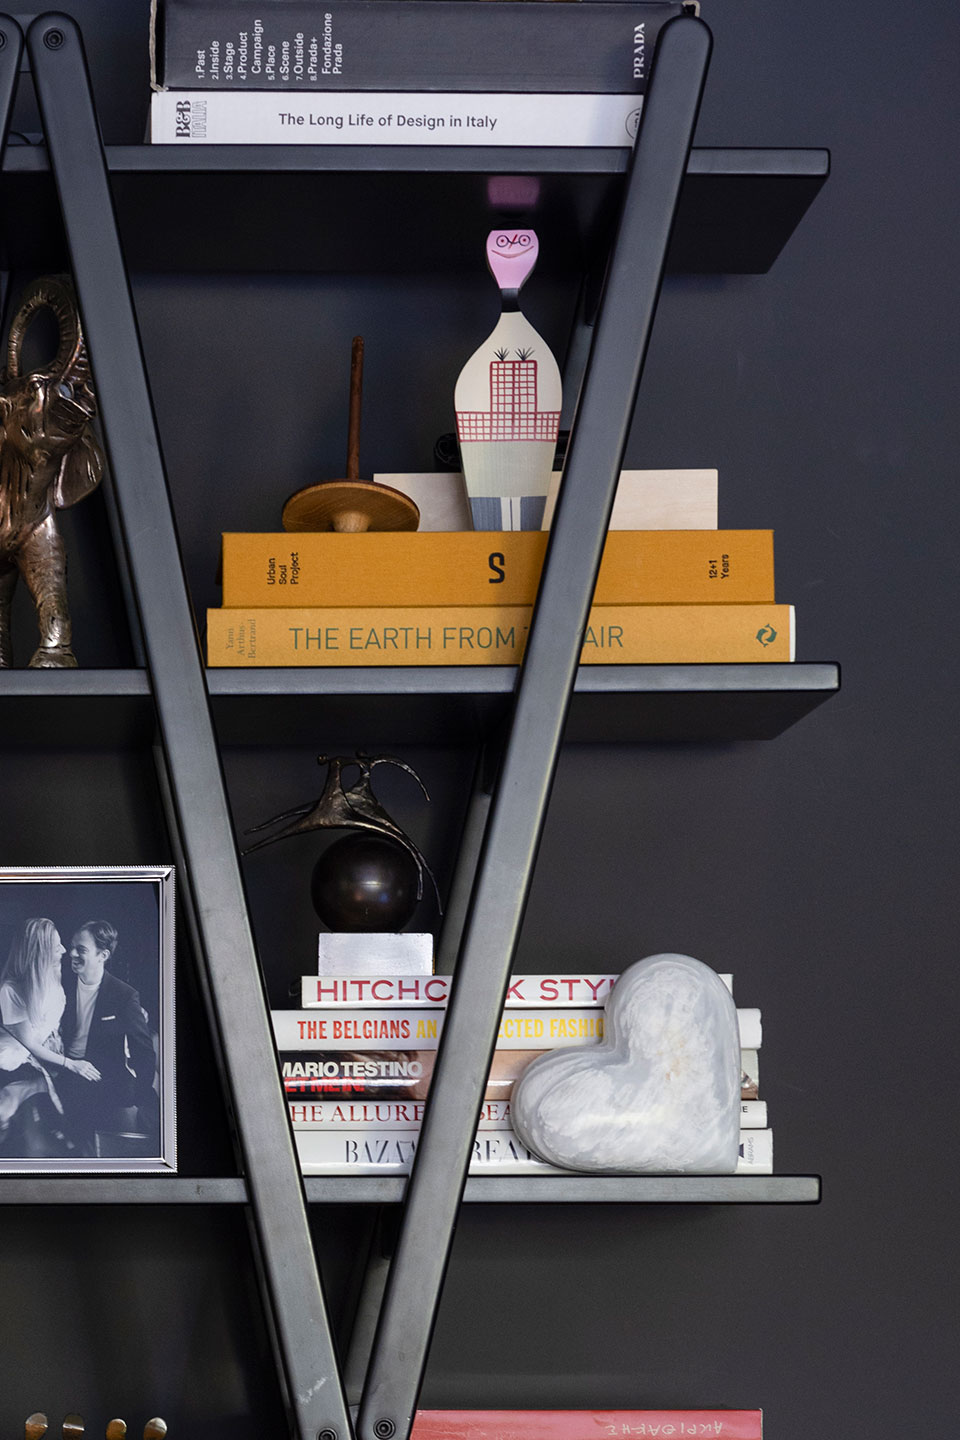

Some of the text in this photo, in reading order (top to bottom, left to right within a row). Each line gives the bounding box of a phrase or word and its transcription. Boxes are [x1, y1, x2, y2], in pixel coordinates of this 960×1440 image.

[209, 40, 220, 80] 2.Inside
[237, 31, 248, 80] 4.Product
[251, 19, 264, 74] Campaign
[279, 40, 290, 81] 6.Scene
[293, 32, 304, 81] 7.Outside
[321, 13, 333, 74] Fondazione
[332, 43, 343, 74] Prada
[633, 22, 645, 79] PRADA
[195, 50, 206, 79] 1.Past
[223, 42, 236, 80] 3.Stage
[265, 45, 276, 80] 5.Place
[175, 100, 191, 138] B&B
[191, 100, 208, 138] ITALIA
[278, 113, 498, 131] The Long Life of Design in Italy
[267, 557, 276, 585] Urban
[279, 564, 288, 585] Soul
[290, 552, 301, 585] Project
[708, 559, 718, 579] 12+1
[720, 554, 730, 580] Years
[247, 618, 257, 659] Bertrand
[288, 625, 625, 650] THE EARTH FROM AIR
[297, 1020, 328, 1040] THE
[332, 1019, 411, 1039] BELGIANS
[282, 1061, 424, 1078] MARIO TESTINO
[329, 1104, 425, 1122] ALLURE
